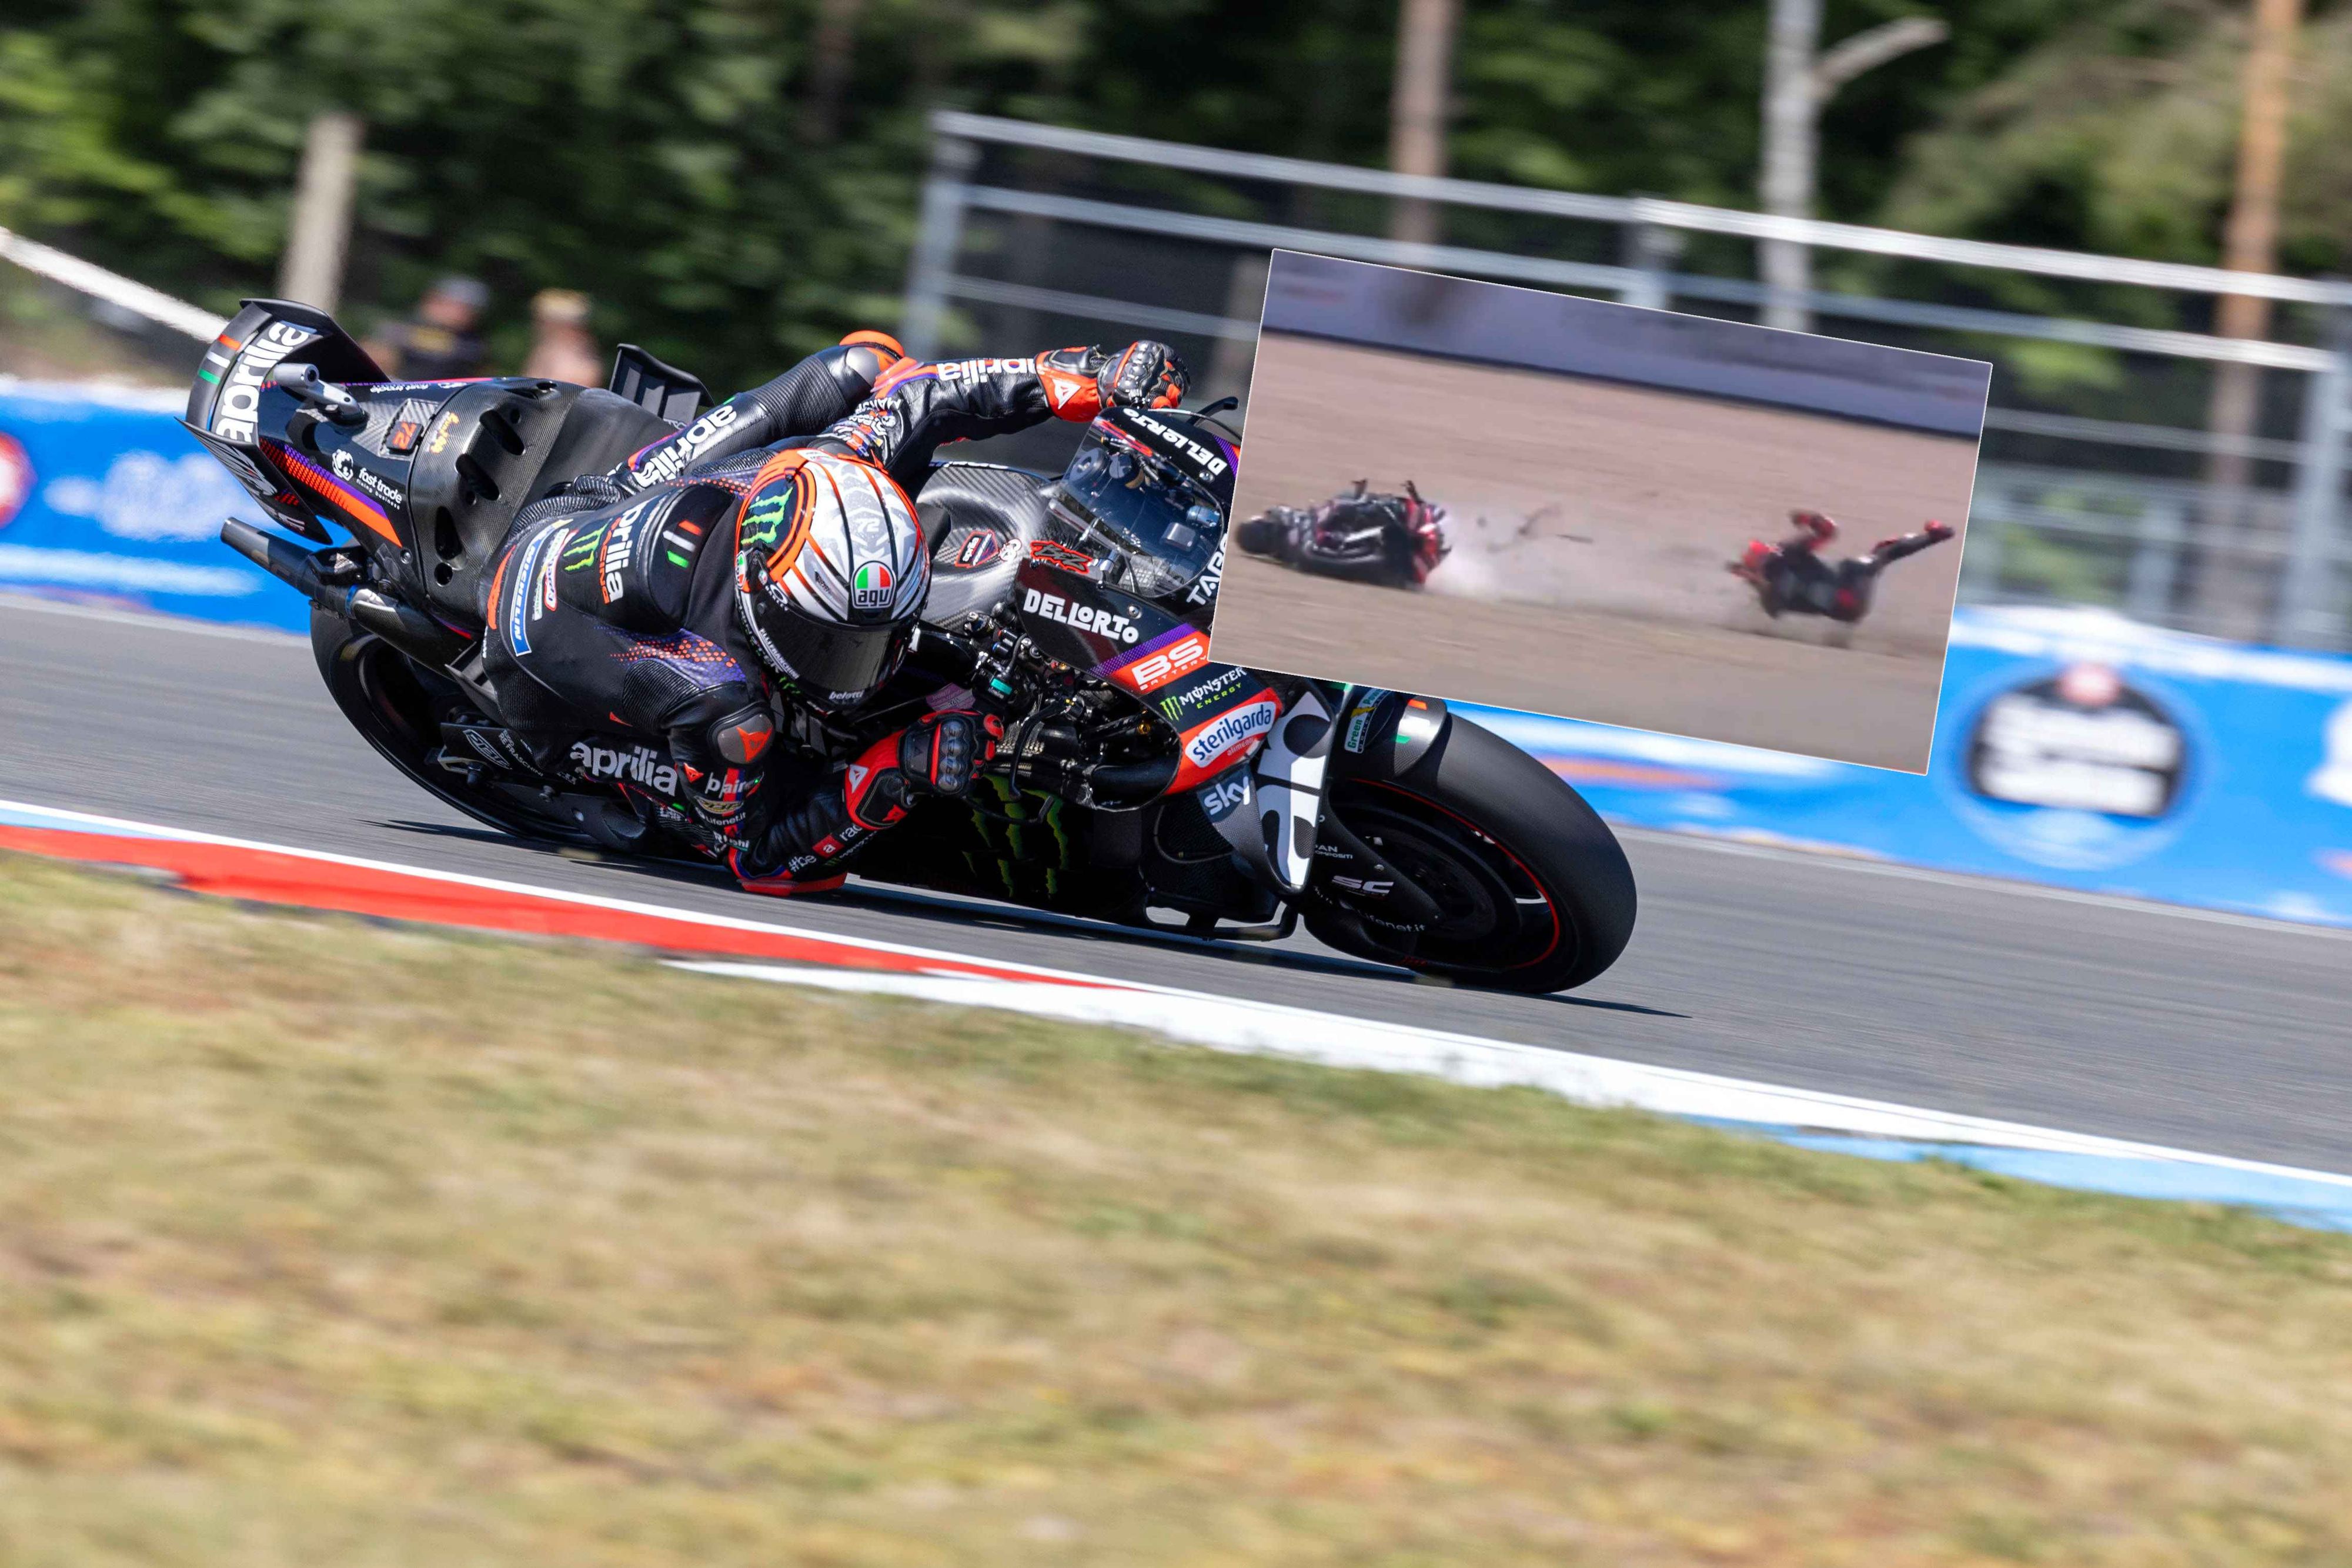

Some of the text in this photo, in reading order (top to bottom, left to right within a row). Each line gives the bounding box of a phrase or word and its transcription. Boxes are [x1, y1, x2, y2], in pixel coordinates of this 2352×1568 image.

[216, 322, 309, 443] aprilia
[937, 359, 1037, 385] prilia
[632, 404, 737, 487] aprilia
[359, 468, 402, 503] fast trade
[854, 519, 879, 531] 72
[606, 497, 654, 602] prilia
[515, 545, 535, 640] MICHELIN
[858, 590, 888, 606] agv
[1131, 638, 1204, 686] BS
[1139, 656, 1207, 690] BATTERY
[1180, 667, 1247, 706] MONSTER
[1197, 683, 1242, 709] ENERGY
[1194, 707, 1272, 761] sterilgarda
[1348, 719, 1362, 748] Green
[570, 741, 677, 797] aprilia
[1204, 776, 1251, 815] sky
[789, 855, 816, 872] #be
